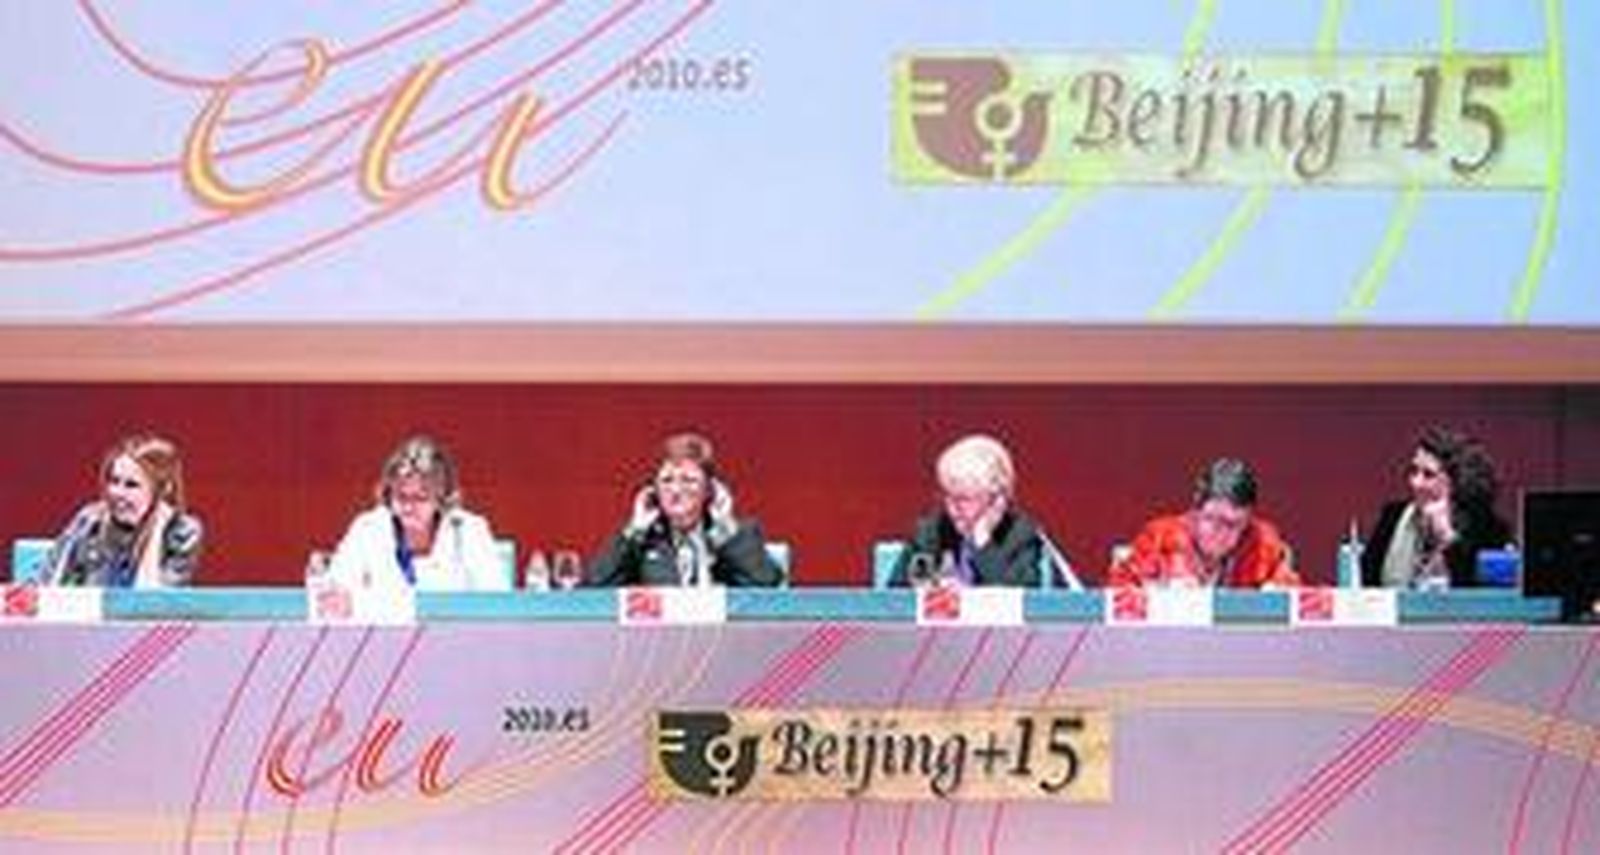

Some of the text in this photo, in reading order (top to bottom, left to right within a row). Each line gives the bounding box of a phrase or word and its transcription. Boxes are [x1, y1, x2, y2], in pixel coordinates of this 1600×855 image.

[626, 59, 751, 92] 2010.es
[1069, 65, 1512, 177] Beijing+15
[503, 707, 590, 732] 2010.es
[772, 715, 1086, 798] Beijing+15
